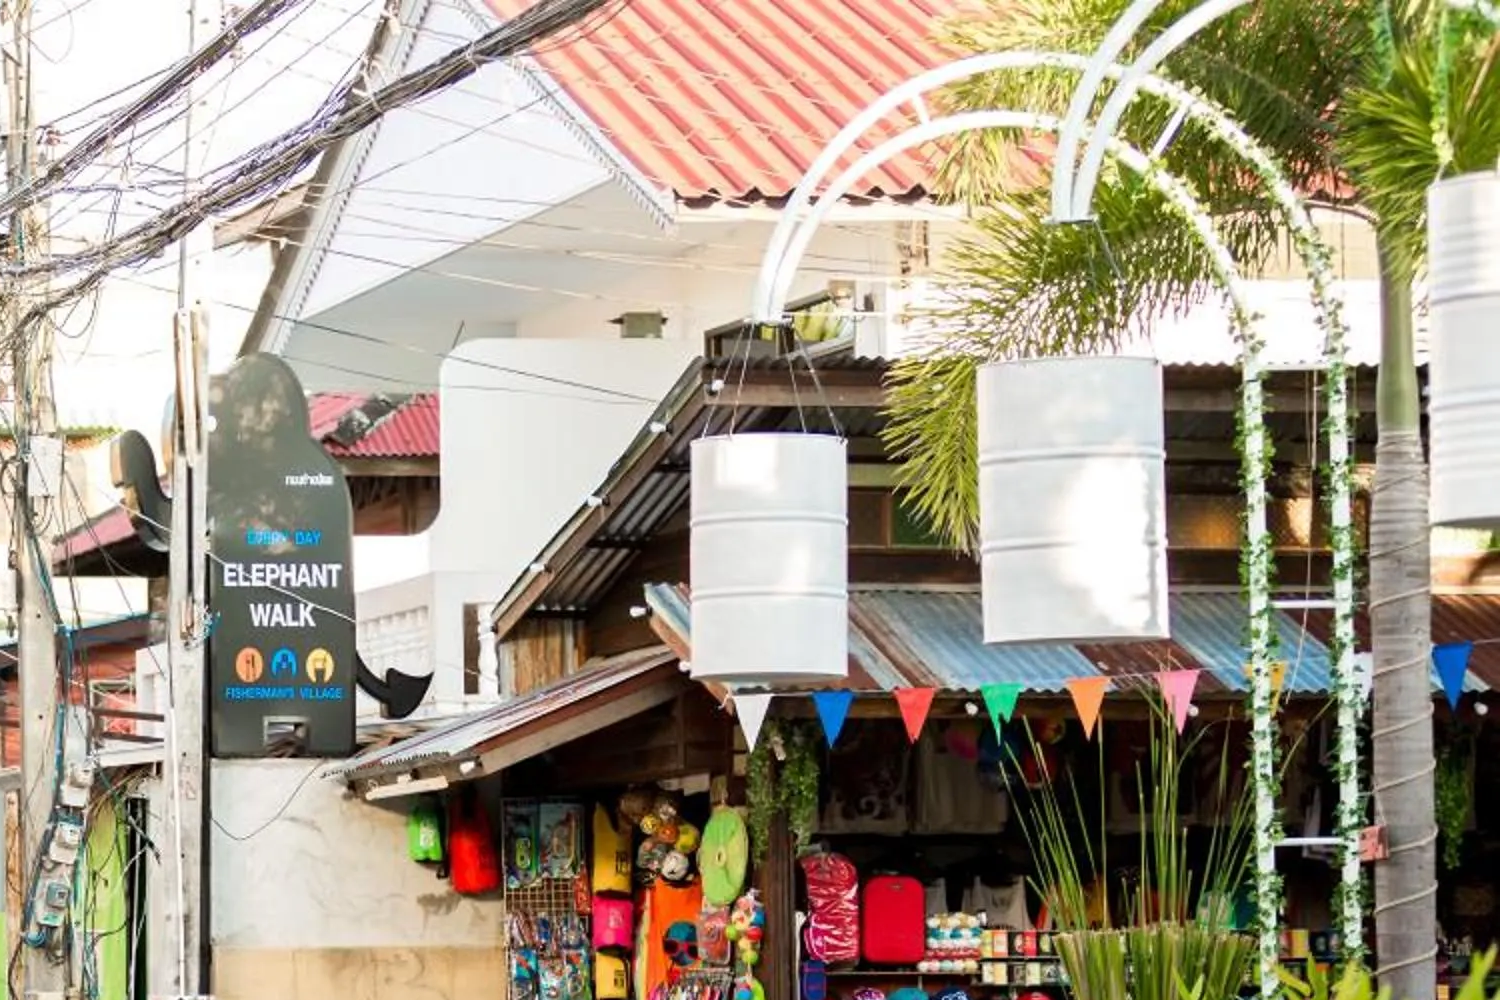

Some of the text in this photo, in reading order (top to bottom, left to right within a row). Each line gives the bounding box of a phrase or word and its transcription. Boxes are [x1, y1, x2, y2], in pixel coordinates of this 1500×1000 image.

[295, 530, 321, 546] DAY
[223, 563, 342, 588] ELEPHANT
[250, 602, 316, 628] WALK
[300, 687, 342, 700] VILLAGE
